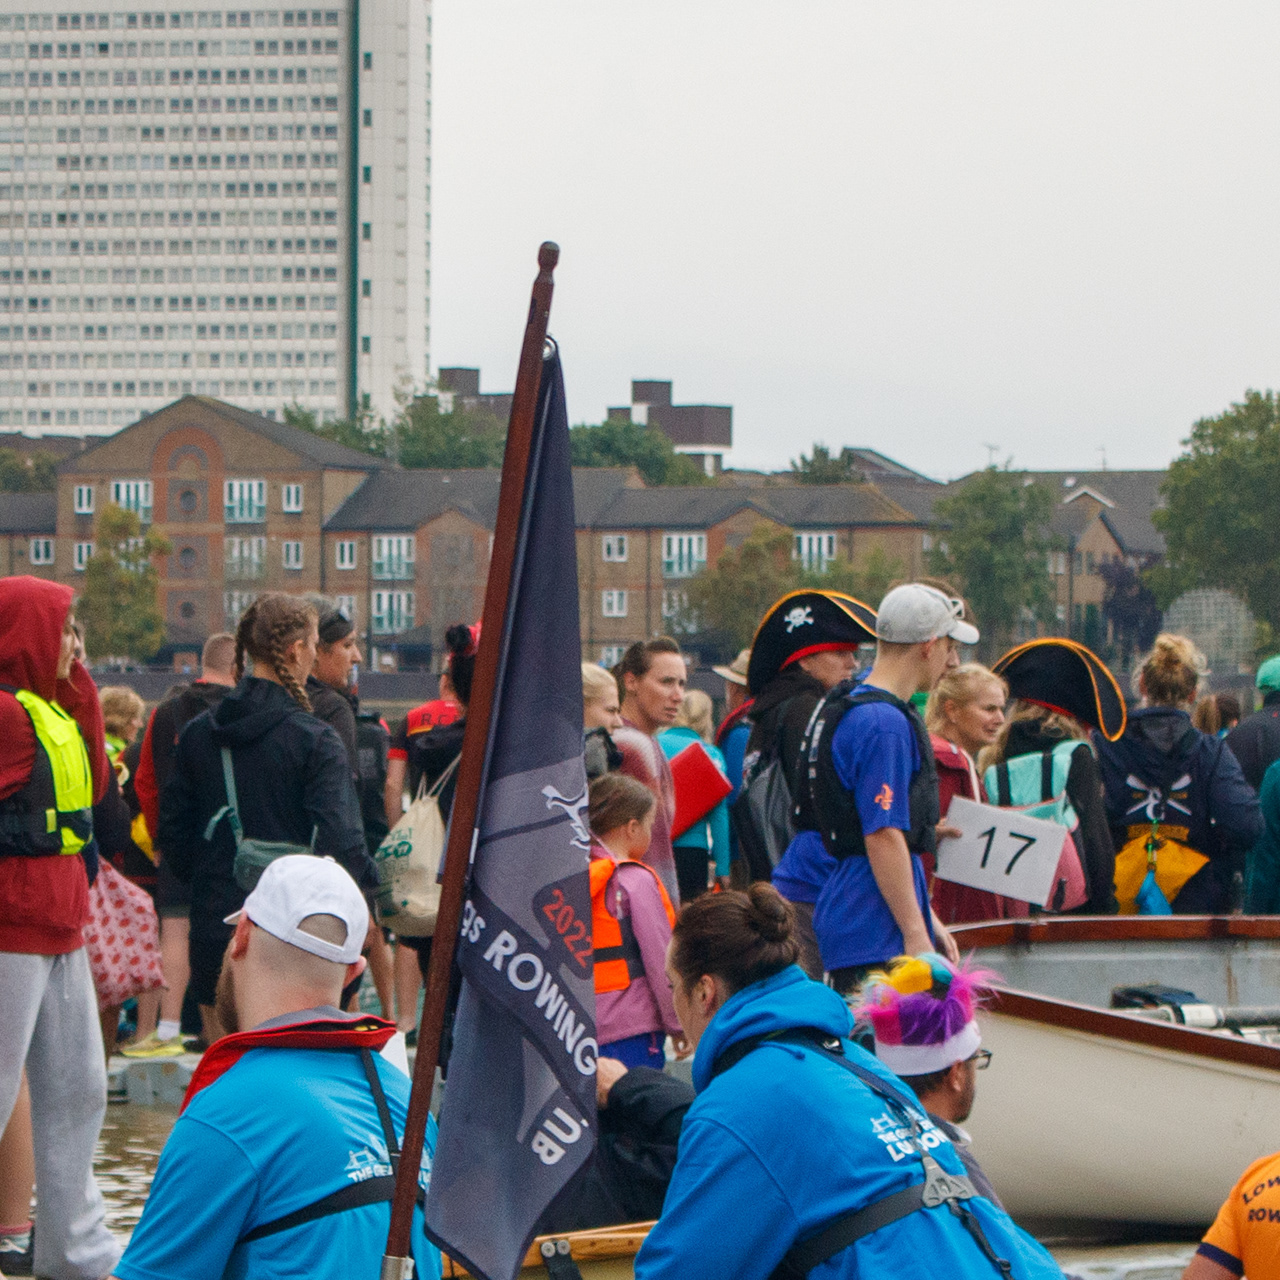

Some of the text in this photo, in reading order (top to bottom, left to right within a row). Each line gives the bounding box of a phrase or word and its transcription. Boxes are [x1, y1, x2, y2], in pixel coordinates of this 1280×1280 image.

[978, 826, 1037, 875] 17
[542, 889, 594, 968] 2022
[483, 929, 599, 1076] ROWING
